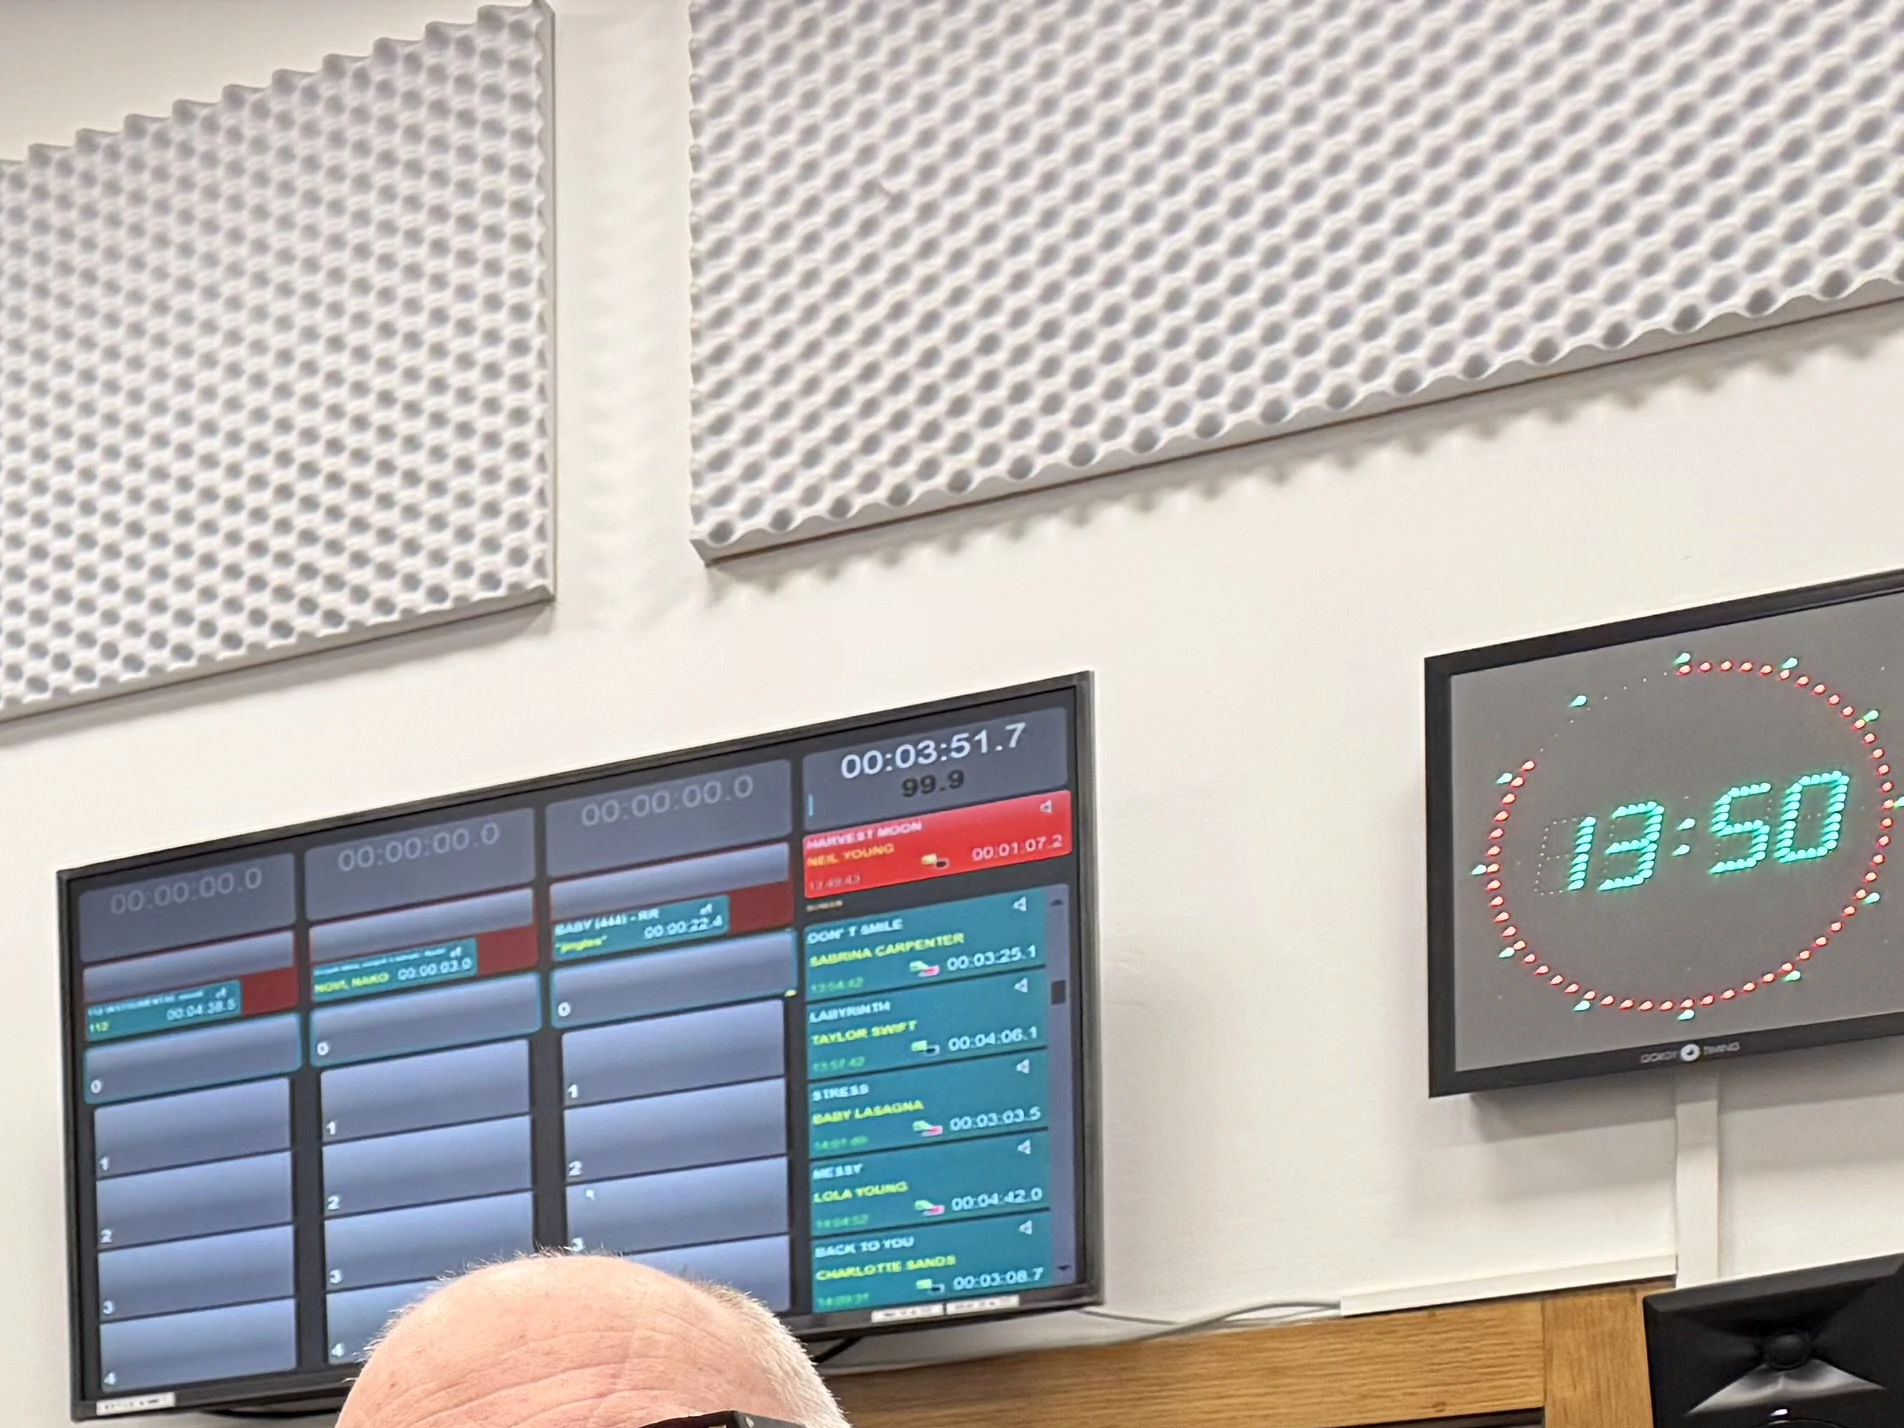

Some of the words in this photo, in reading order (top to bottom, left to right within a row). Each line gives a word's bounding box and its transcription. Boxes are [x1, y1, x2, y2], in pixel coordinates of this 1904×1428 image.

[841, 721, 1026, 780] 00:03:51.7
[901, 769, 965, 798] 99.9
[581, 775, 754, 826] 00:00:00.0
[806, 830, 874, 850] HARVEST
[877, 820, 923, 838] MOON
[1568, 769, 1850, 892] 13:50
[337, 822, 501, 872] 00:00:00.0
[806, 852, 840, 868] NEIL
[843, 843, 895, 861] YOUNG
[972, 834, 1063, 862] 00:01:07.2
[111, 867, 262, 914] 00:00:00.0
[810, 948, 872, 967] SABRINA
[875, 932, 965, 956] CARPENTER
[947, 945, 1036, 971] 00:03:25.1
[809, 1001, 891, 1023] LABYRINTH
[811, 1027, 868, 1046] TAYLOR
[871, 1020, 917, 1037] SWIFT
[948, 1026, 1037, 1051] 00:04:06.1
[316, 1042, 329, 1056] 0
[568, 1083, 579, 1098] 1
[812, 1109, 852, 1126] BABY
[855, 1099, 925, 1120] LASAGNA
[950, 1106, 1041, 1132] 00:03:03.5
[326, 1121, 337, 1136] 1
[99, 1156, 110, 1171] 1
[568, 1160, 583, 1176] 2
[327, 1196, 340, 1211] 2
[813, 1188, 853, 1204] LOLA
[855, 1180, 909, 1197] YOUNG
[100, 1229, 113, 1244] 2
[572, 1237, 585, 1251] 3
[815, 1244, 856, 1259] BACK
[861, 1240, 880, 1252] TO
[883, 1236, 914, 1250] YOU
[329, 1269, 343, 1284] 3
[815, 1261, 902, 1281] CHARLOTTE
[906, 1254, 957, 1271] SANDS
[102, 1301, 116, 1315] 3
[331, 1343, 345, 1357] 4
[103, 1372, 117, 1386] 4
